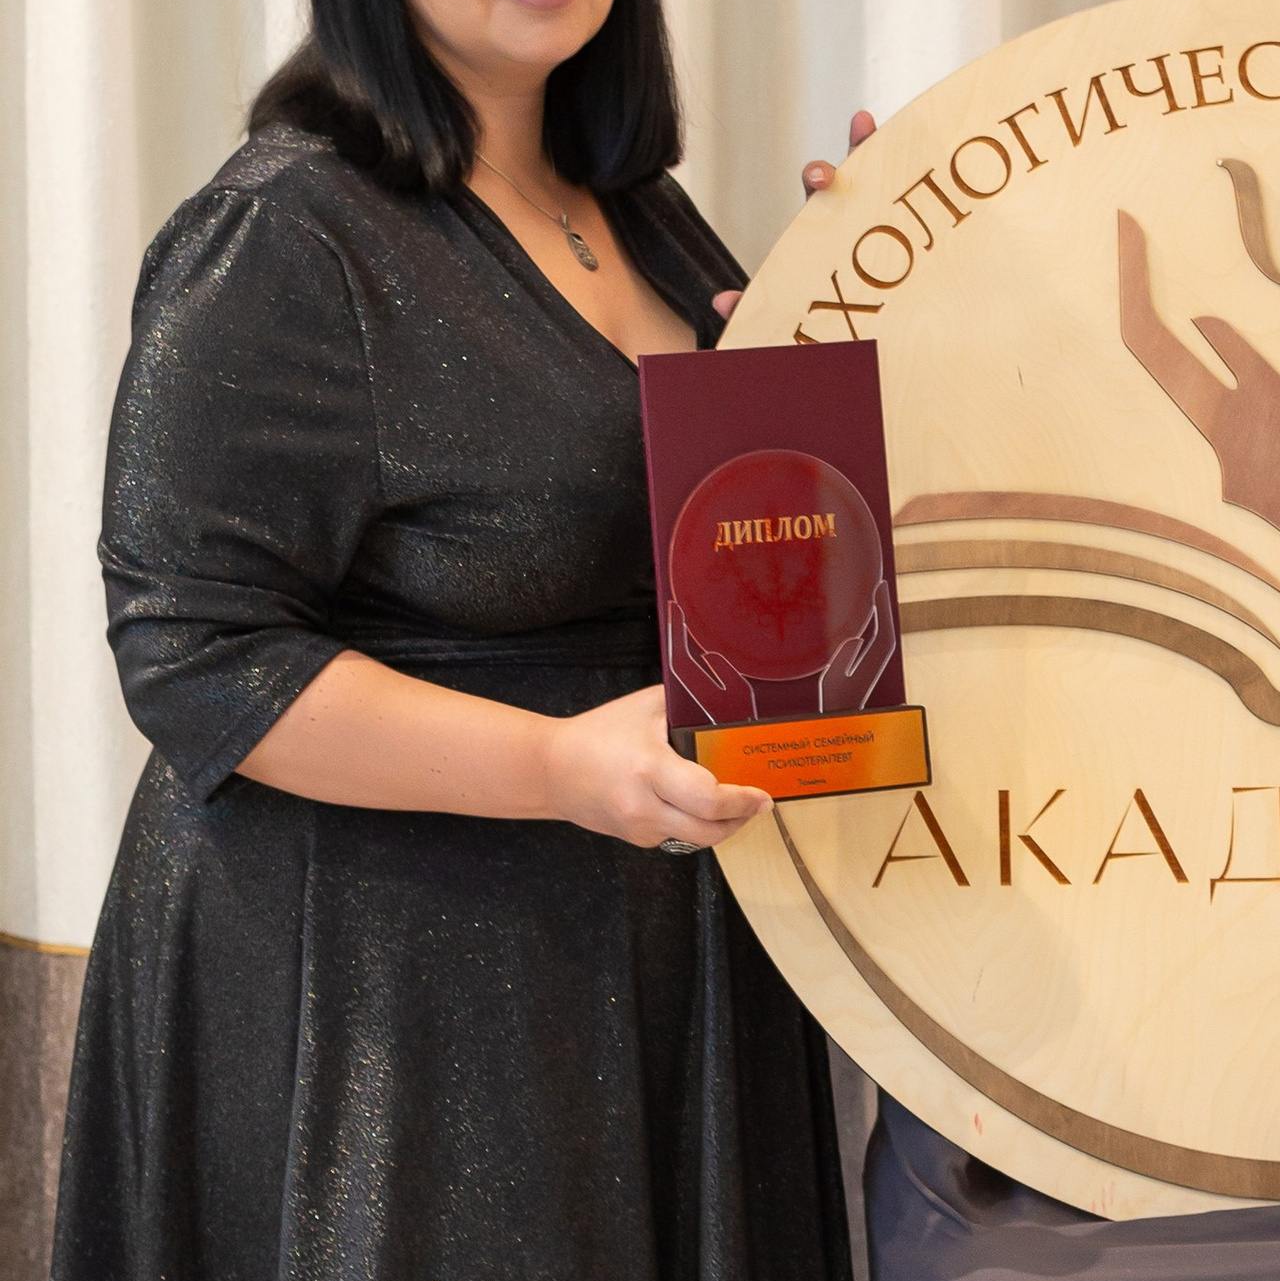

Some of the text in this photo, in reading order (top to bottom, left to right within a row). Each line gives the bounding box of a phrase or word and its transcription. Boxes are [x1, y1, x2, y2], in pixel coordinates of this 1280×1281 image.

[714, 512, 837, 552] ДИПЛОМ
[742, 730, 875, 756] СИСТЕМНЫЙ СЕМЕЙНЫЙ
[767, 751, 853, 770] ПСИХОТЕРАПЕВТ
